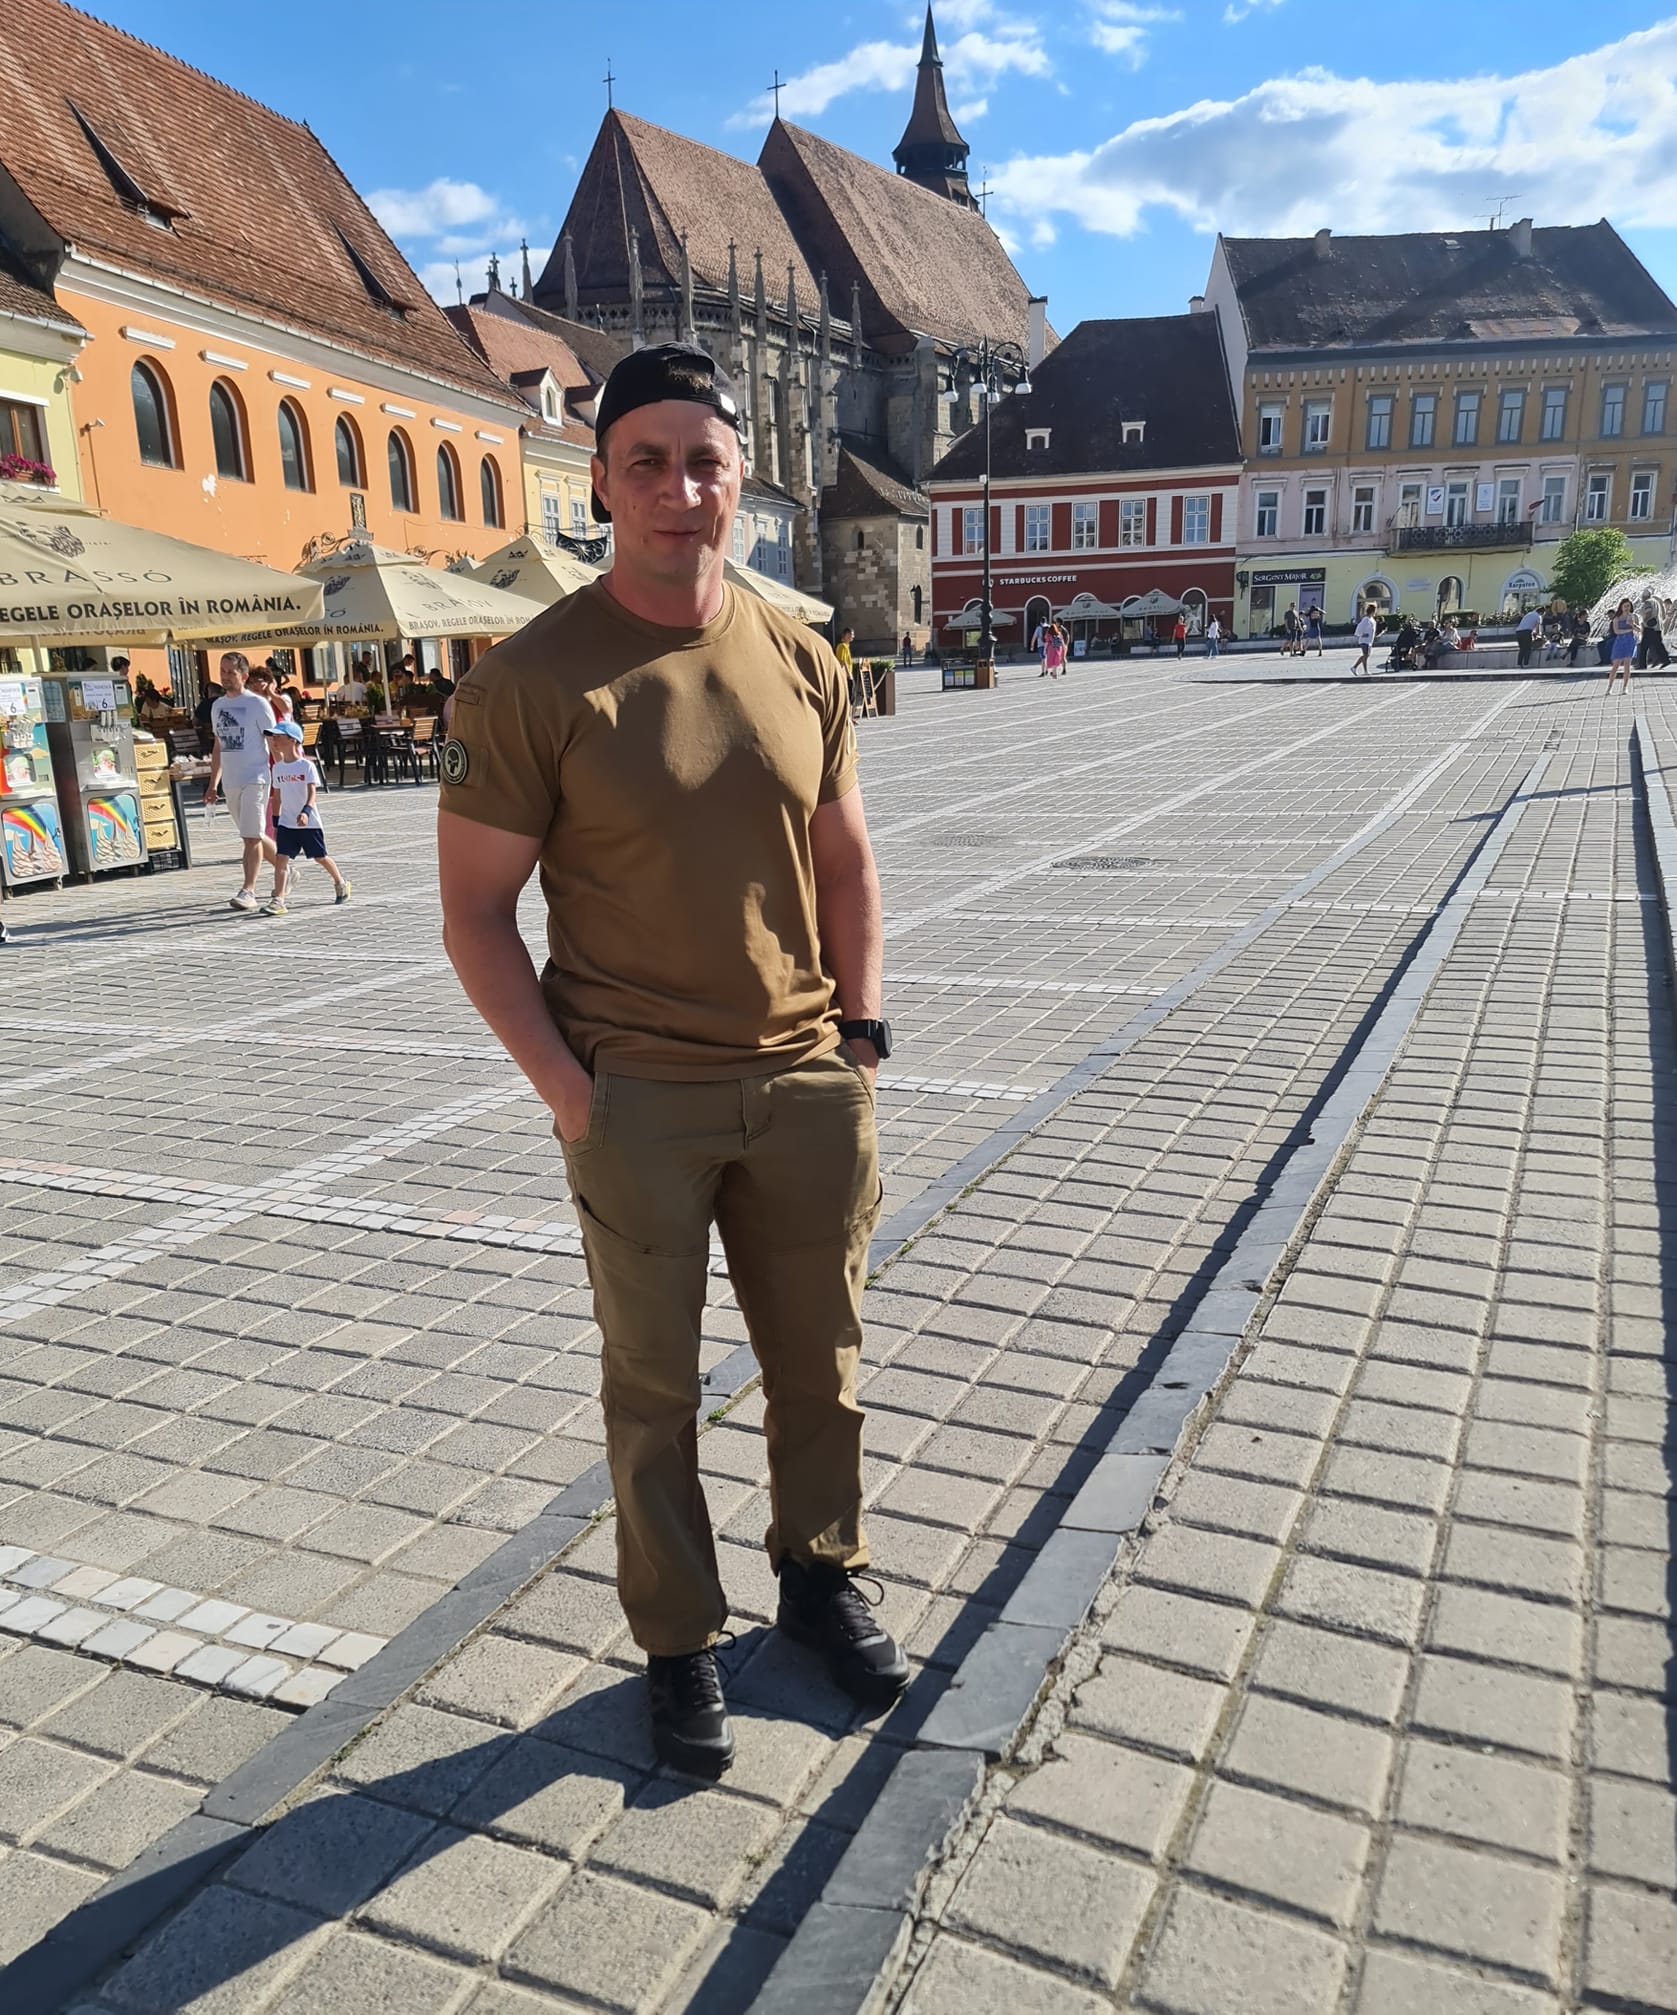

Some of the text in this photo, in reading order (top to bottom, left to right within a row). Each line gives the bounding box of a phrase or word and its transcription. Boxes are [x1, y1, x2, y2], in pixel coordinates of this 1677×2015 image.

[1000, 575, 1046, 585] STARBUCKS
[0, 594, 301, 622] EGELE ORAȘELOR ÎN ROMÂNIA.
[442, 616, 468, 627] REGELE
[10, 702, 17, 713] 6
[101, 698, 108, 709] 6
